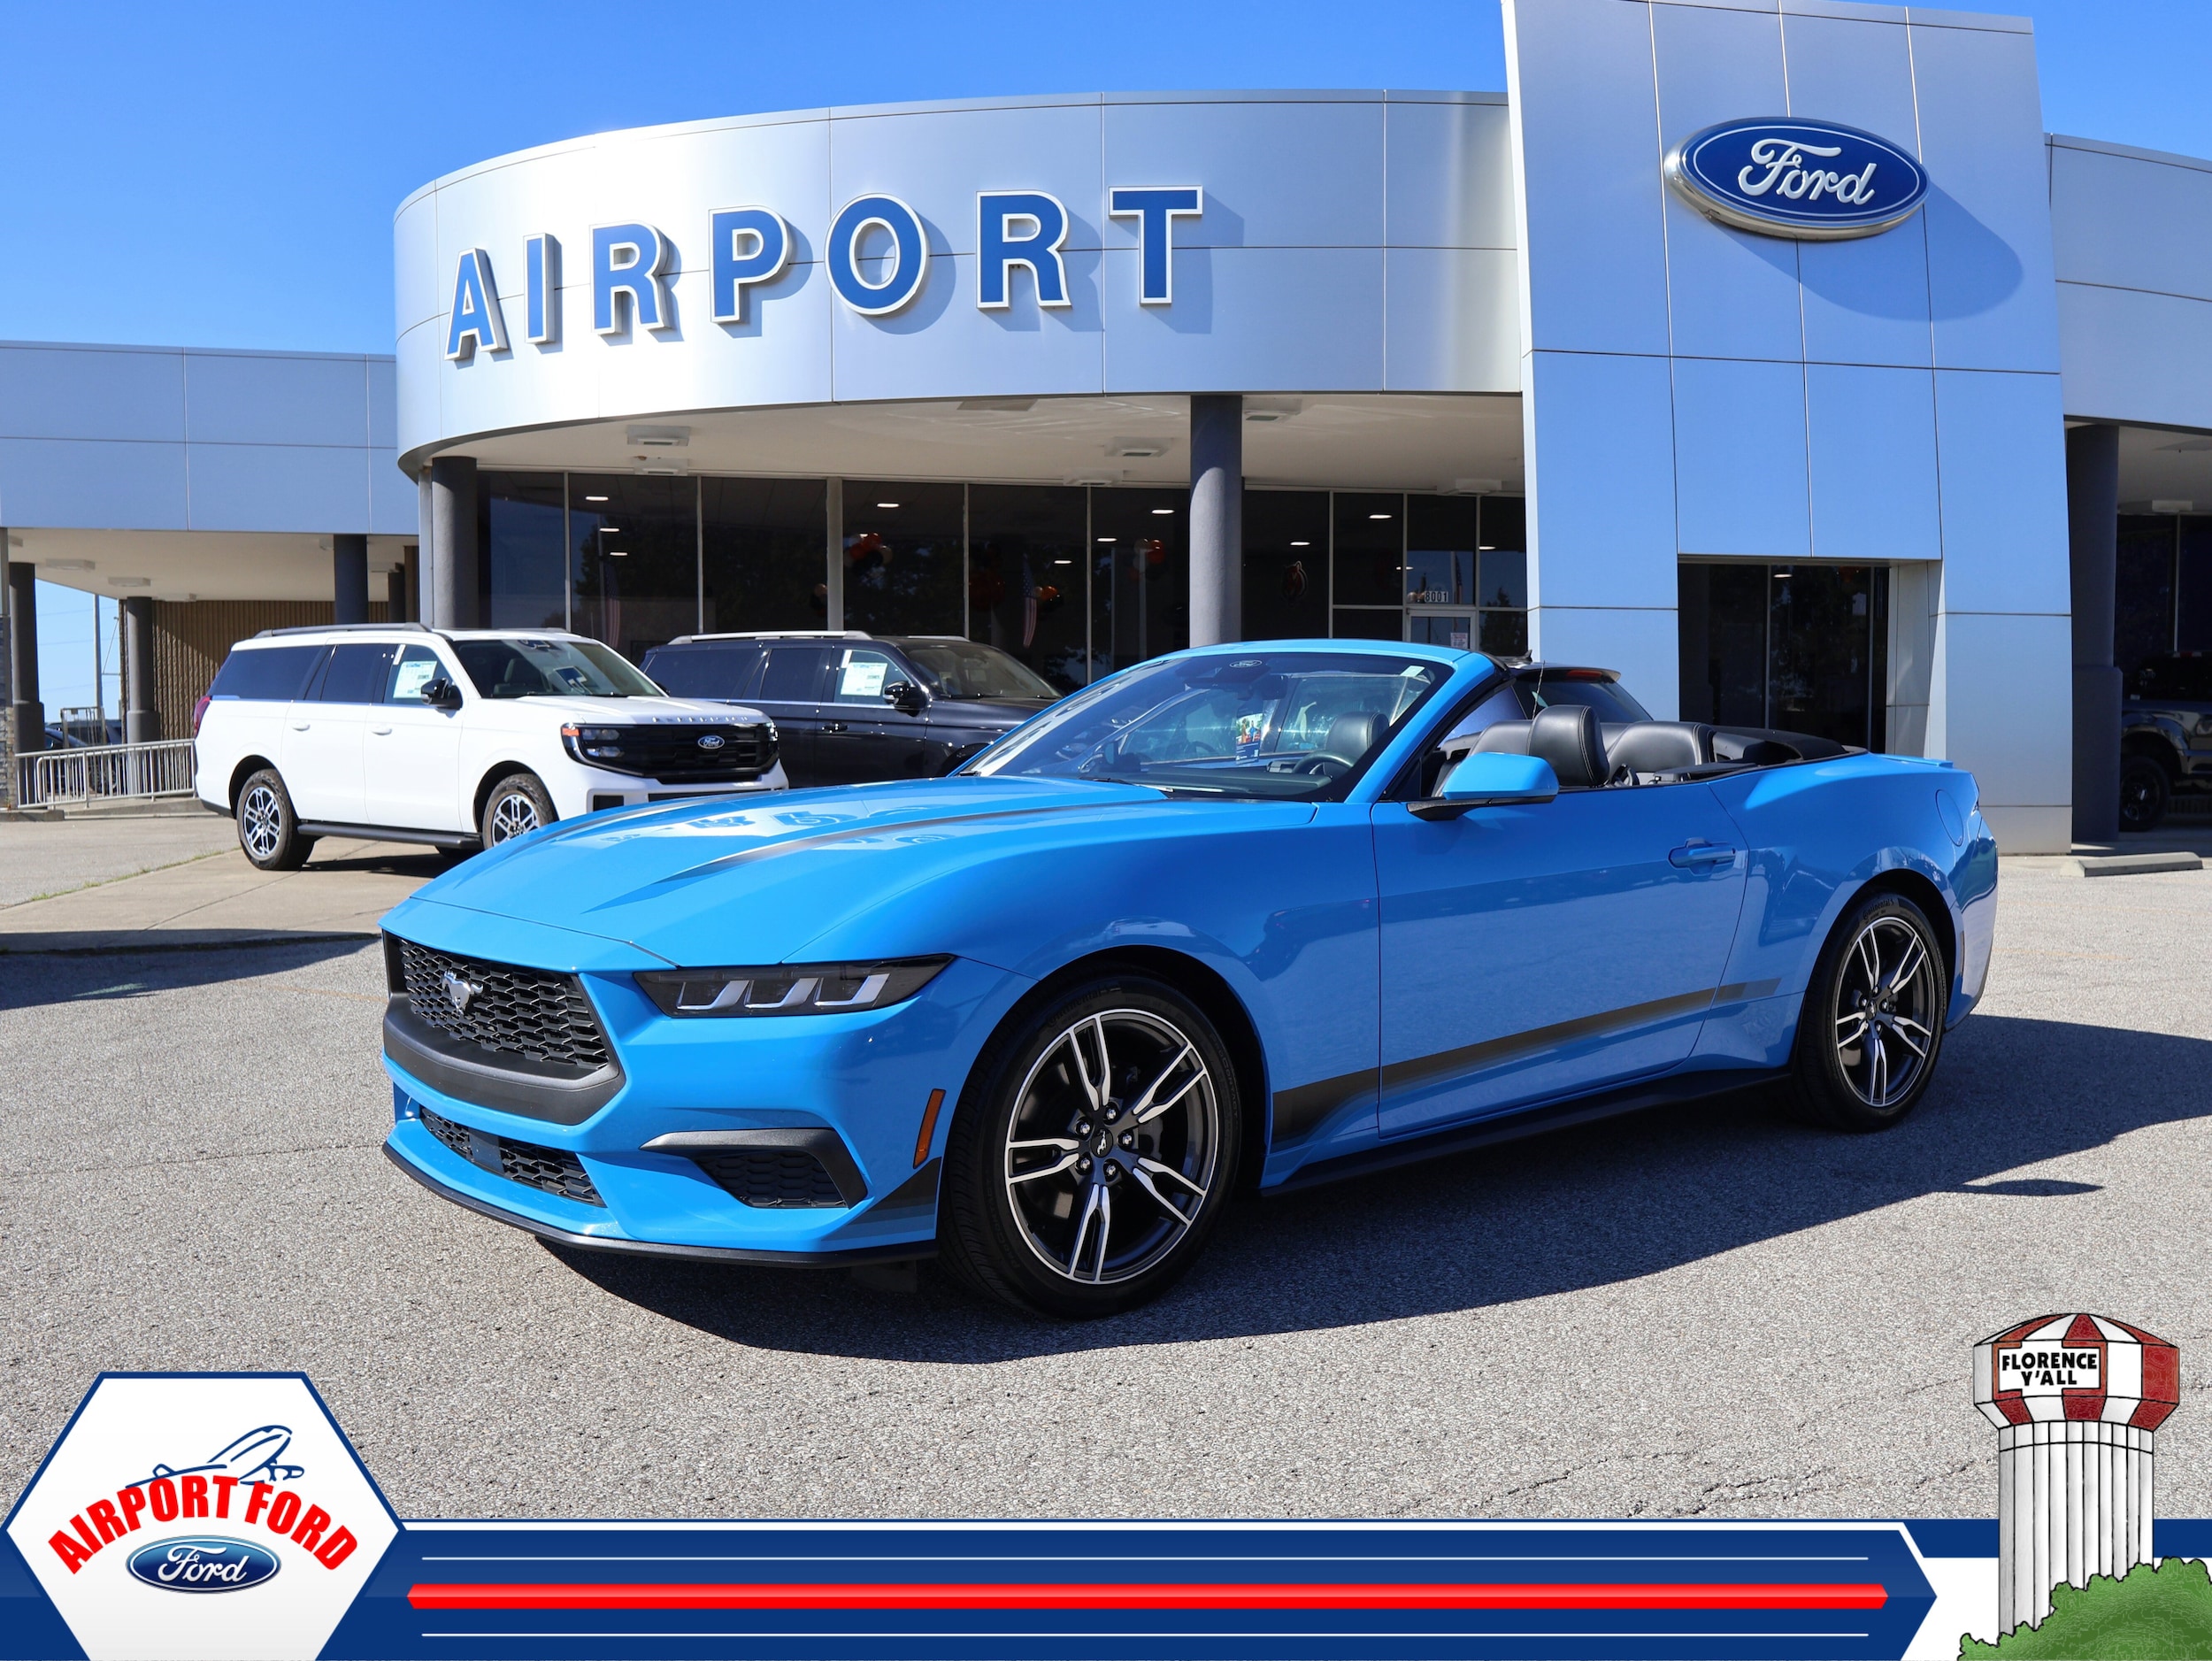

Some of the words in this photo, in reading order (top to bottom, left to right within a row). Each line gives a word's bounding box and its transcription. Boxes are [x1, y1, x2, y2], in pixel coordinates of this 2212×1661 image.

[1738, 138, 1877, 205] Ford
[444, 186, 1204, 362] AIRPORT
[1425, 591, 1448, 602] 8001
[1048, 985, 1102, 1027] Continental
